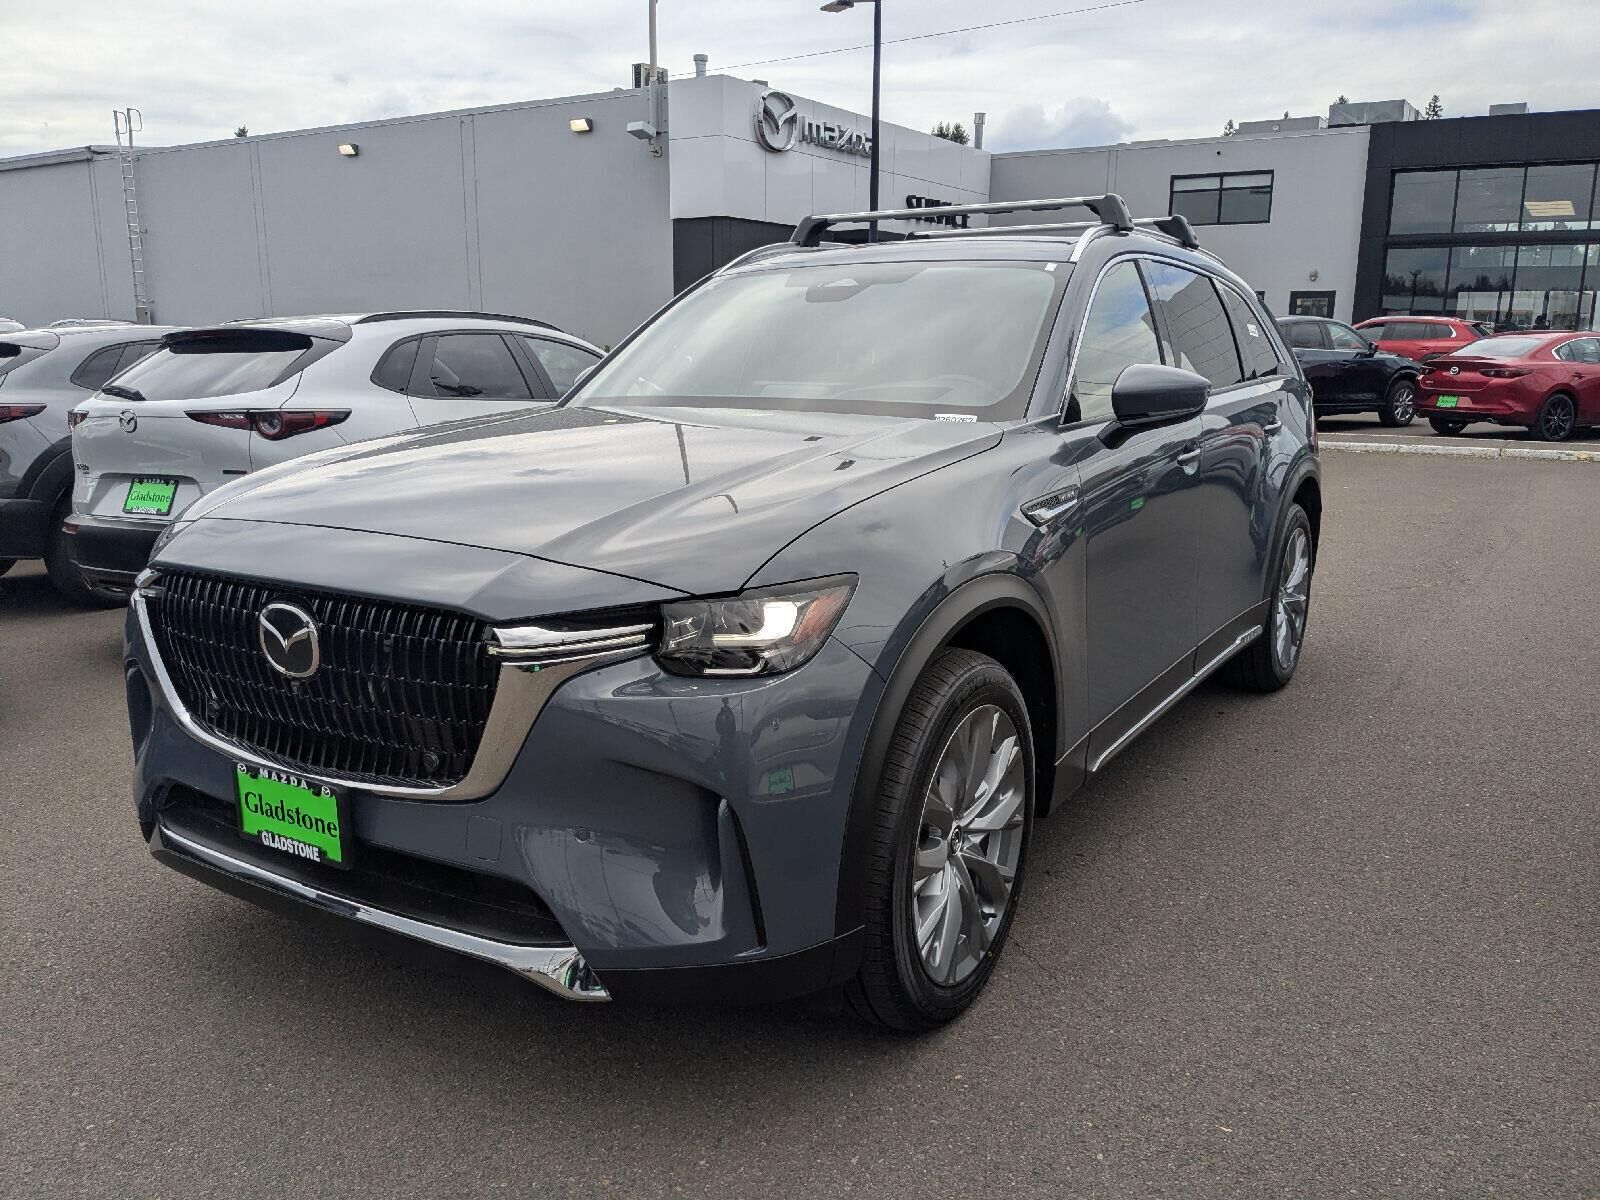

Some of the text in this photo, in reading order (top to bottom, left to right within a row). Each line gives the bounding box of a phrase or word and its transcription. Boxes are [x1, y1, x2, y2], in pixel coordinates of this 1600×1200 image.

[130, 491, 171, 503] Gladstone
[259, 768, 309, 790] MAZDA
[244, 791, 338, 838] Gladstone
[261, 831, 321, 862] GLADSTONE
